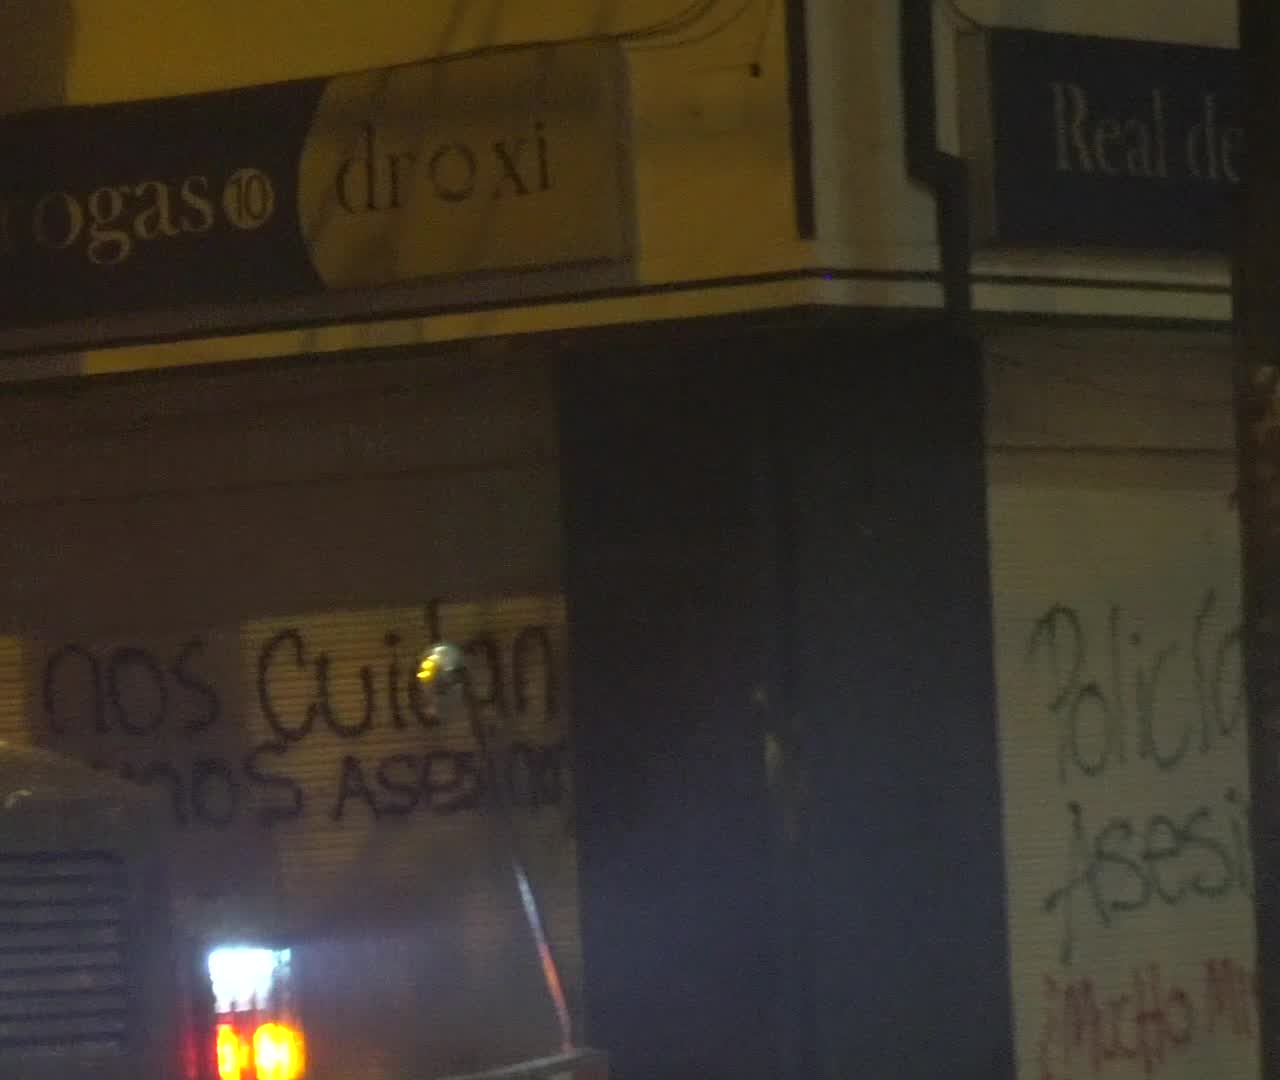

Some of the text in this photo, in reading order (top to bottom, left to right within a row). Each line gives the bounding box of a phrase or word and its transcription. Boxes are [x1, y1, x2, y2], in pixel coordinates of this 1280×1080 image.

[336, 120, 554, 214] droxi
[1049, 81, 1243, 183] Real de
